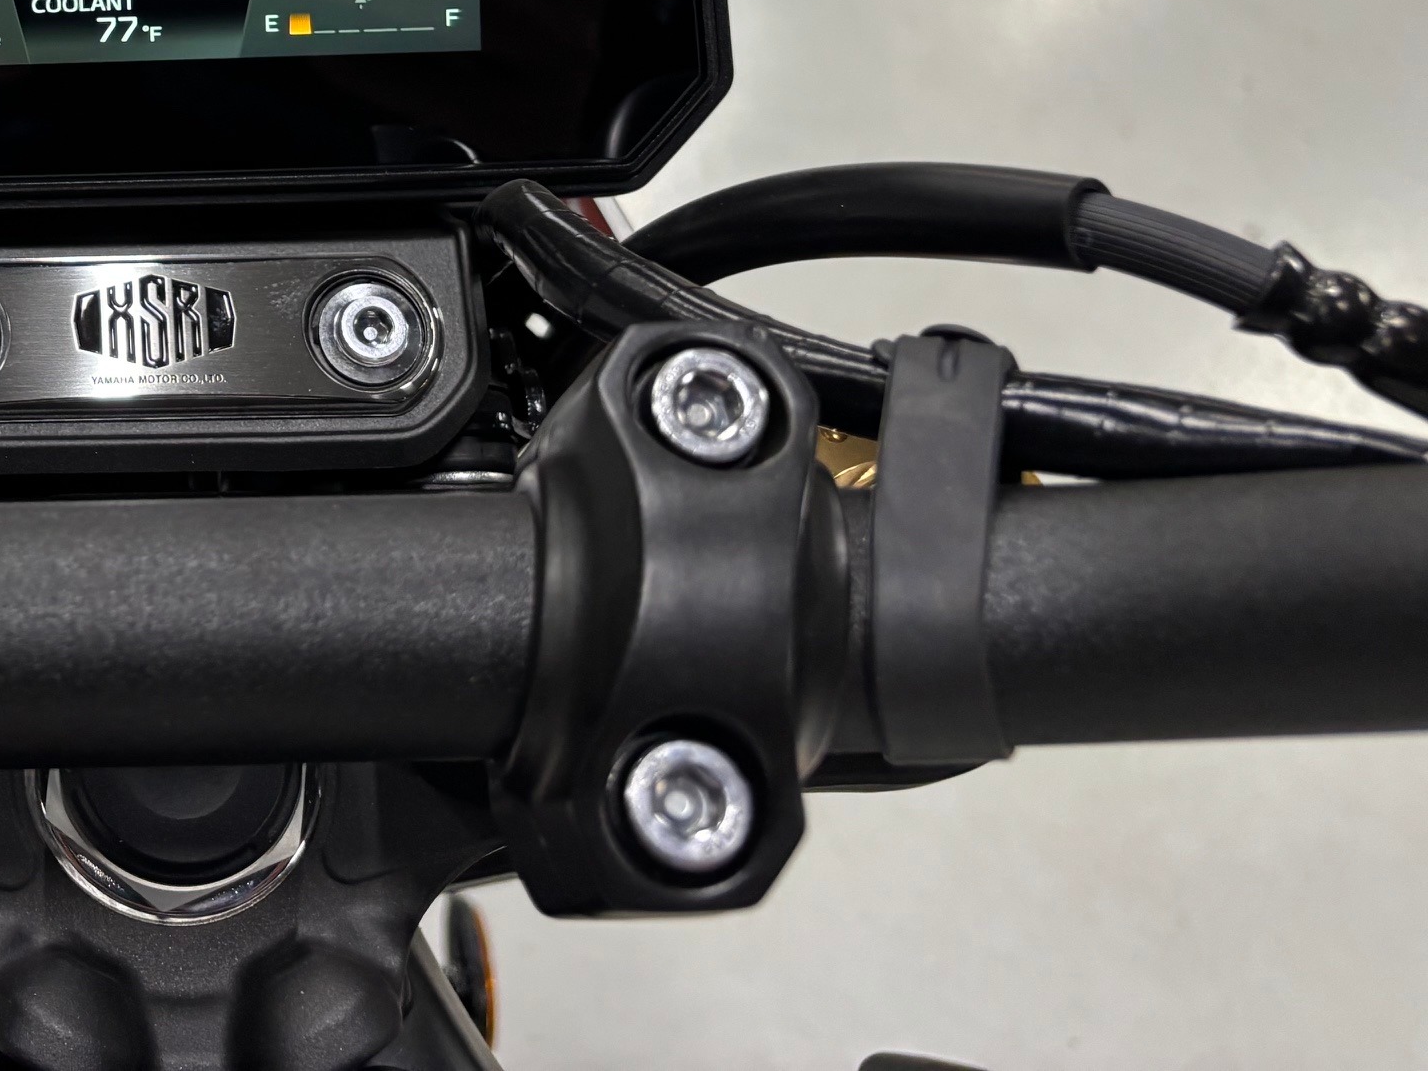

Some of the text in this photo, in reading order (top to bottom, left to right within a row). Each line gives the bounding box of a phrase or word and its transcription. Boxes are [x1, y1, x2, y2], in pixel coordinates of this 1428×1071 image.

[265, 14, 280, 33] E
[445, 8, 462, 27] F
[96, 16, 138, 43] 77
[106, 273, 205, 369] XSR
[91, 375, 135, 385] YAMAHA
[138, 373, 178, 384] MOTOR
